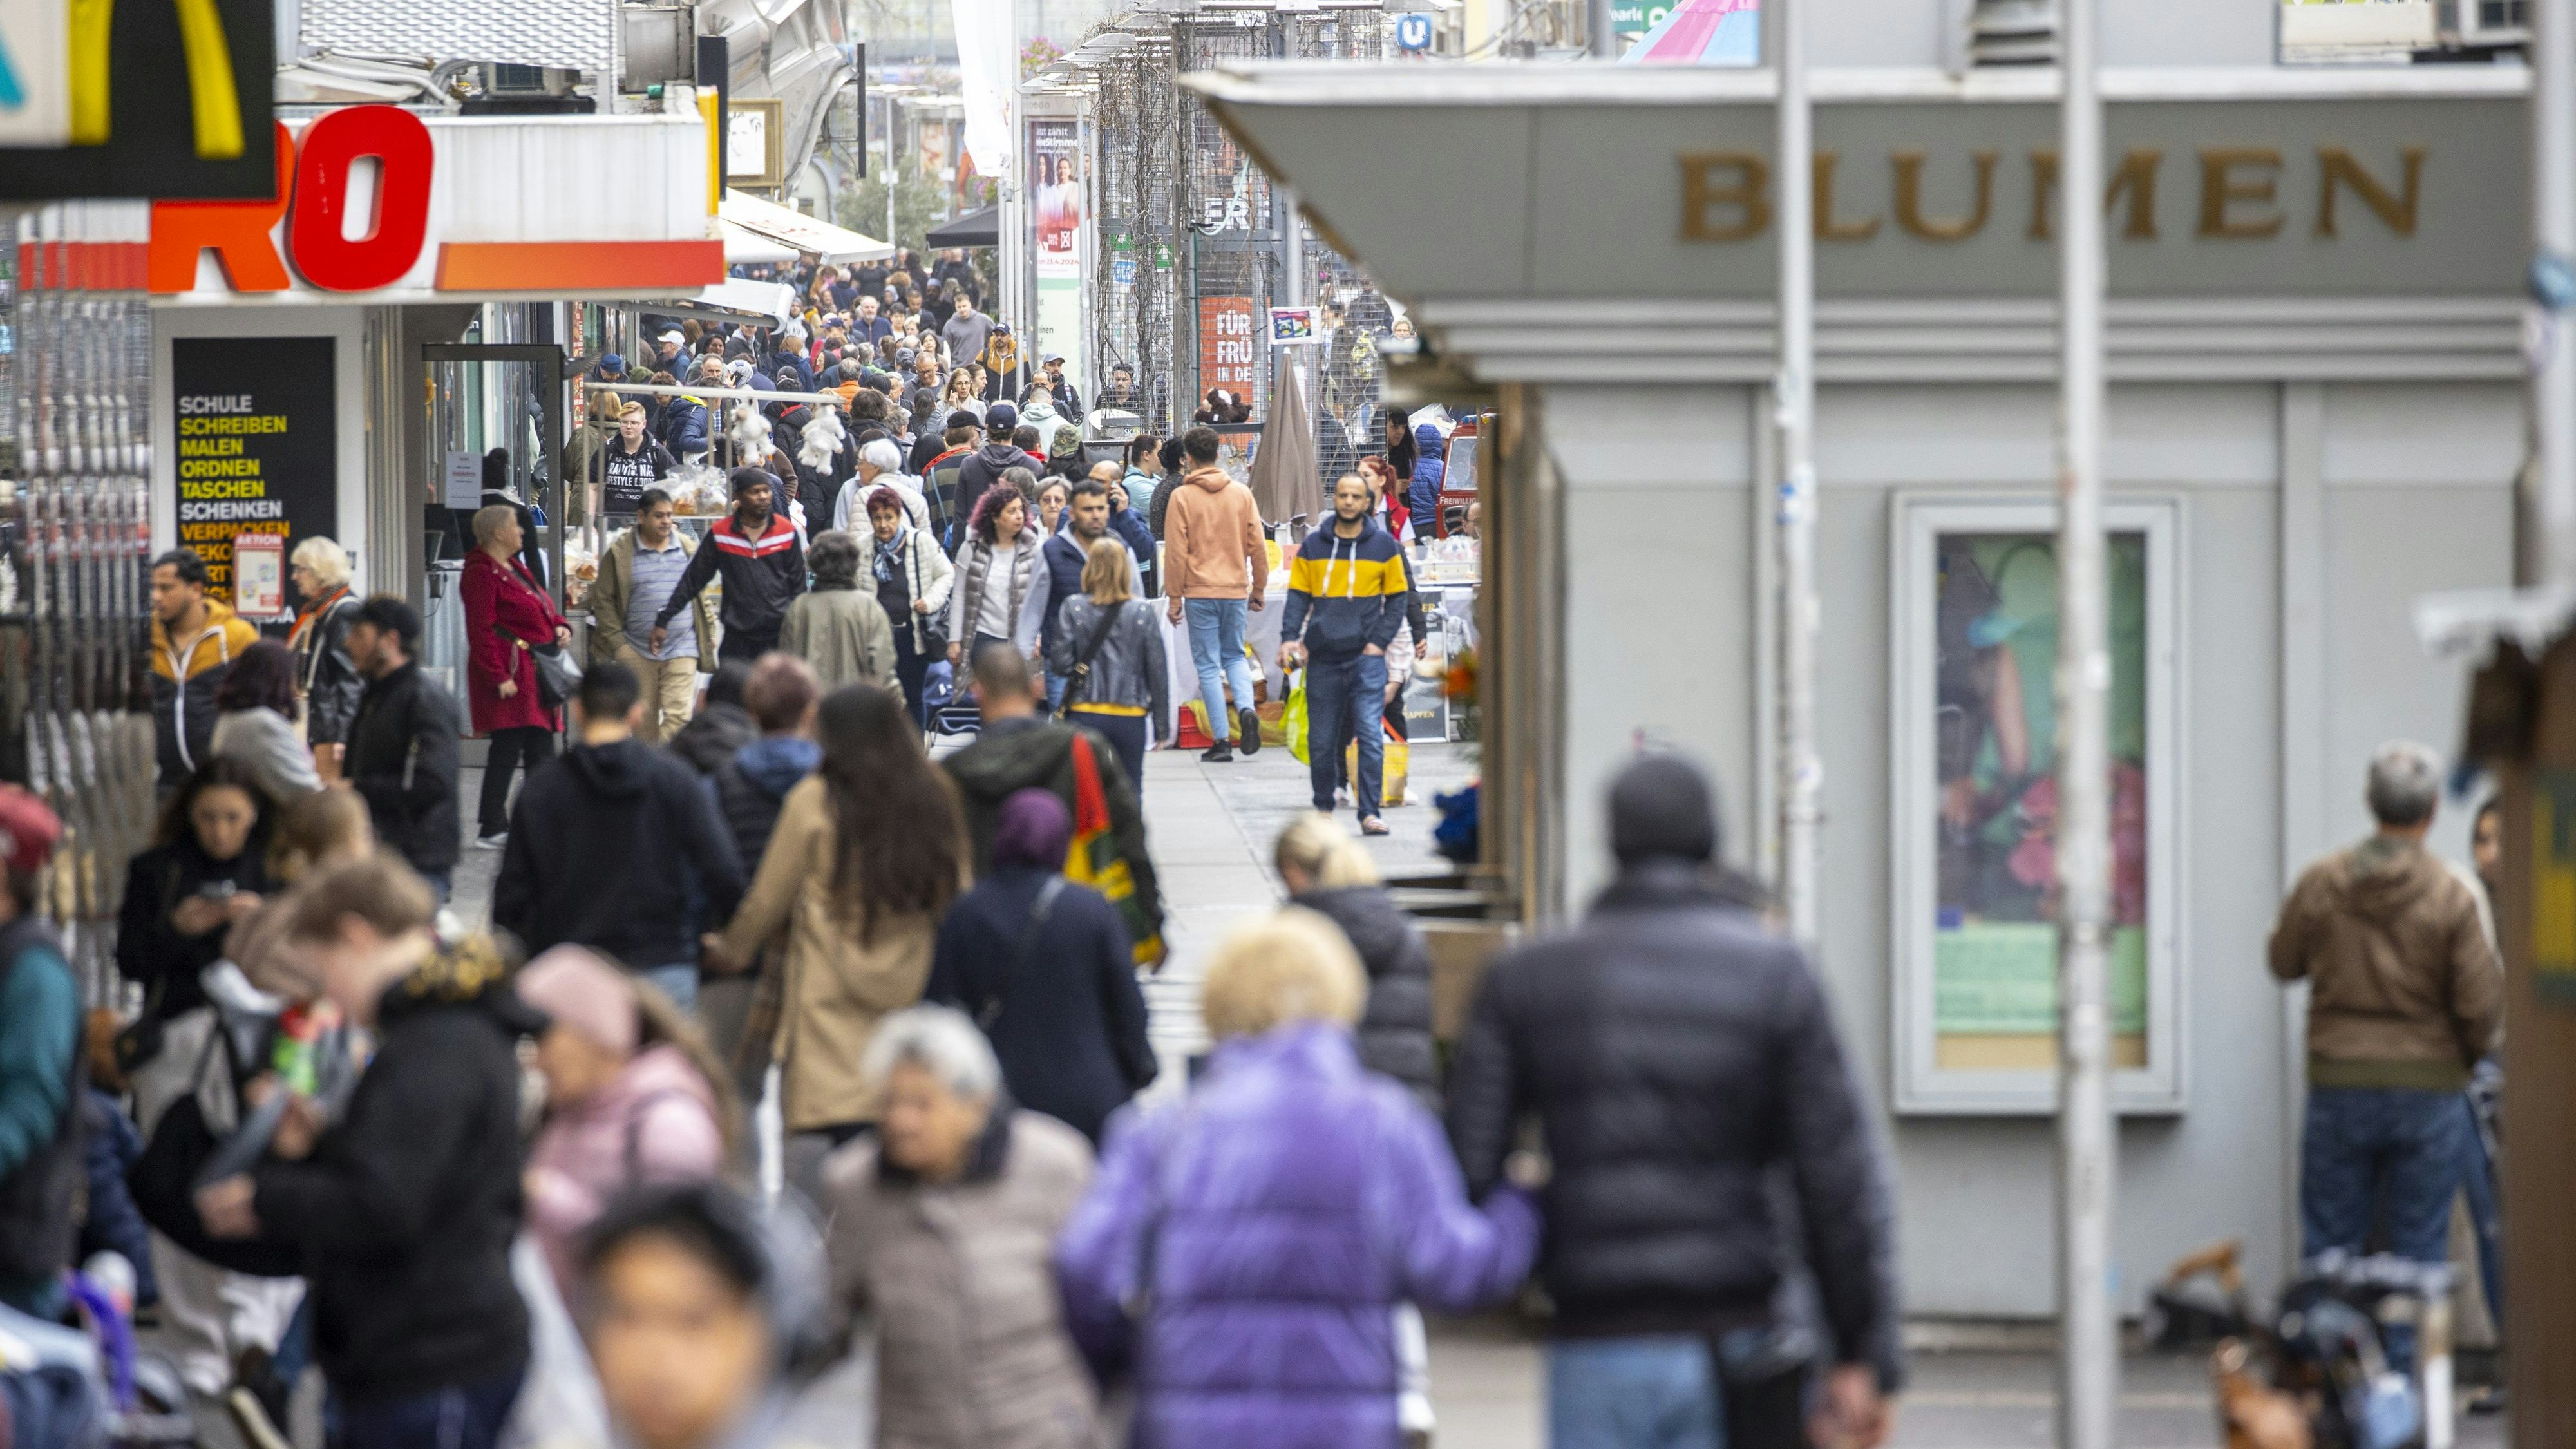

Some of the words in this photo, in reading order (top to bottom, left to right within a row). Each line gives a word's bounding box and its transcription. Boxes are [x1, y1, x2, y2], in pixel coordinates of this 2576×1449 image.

[1610, 6, 1642, 21] earle
[1401, 20, 1426, 46] U
[1677, 147, 2430, 242] BLUMEN
[1217, 310, 1251, 335] FÜR
[1217, 336, 1253, 363] FRÜ
[1218, 367, 1229, 382] IN
[1235, 367, 1253, 382] DE
[180, 395, 252, 414] SCHULE
[180, 416, 287, 435] SCHREIBEN
[180, 438, 243, 456] MALEN
[180, 459, 260, 478] ORDNEN
[180, 480, 265, 498] TASCHEN
[180, 500, 282, 520] SCHENKEN
[181, 521, 290, 540] VERPACKEN
